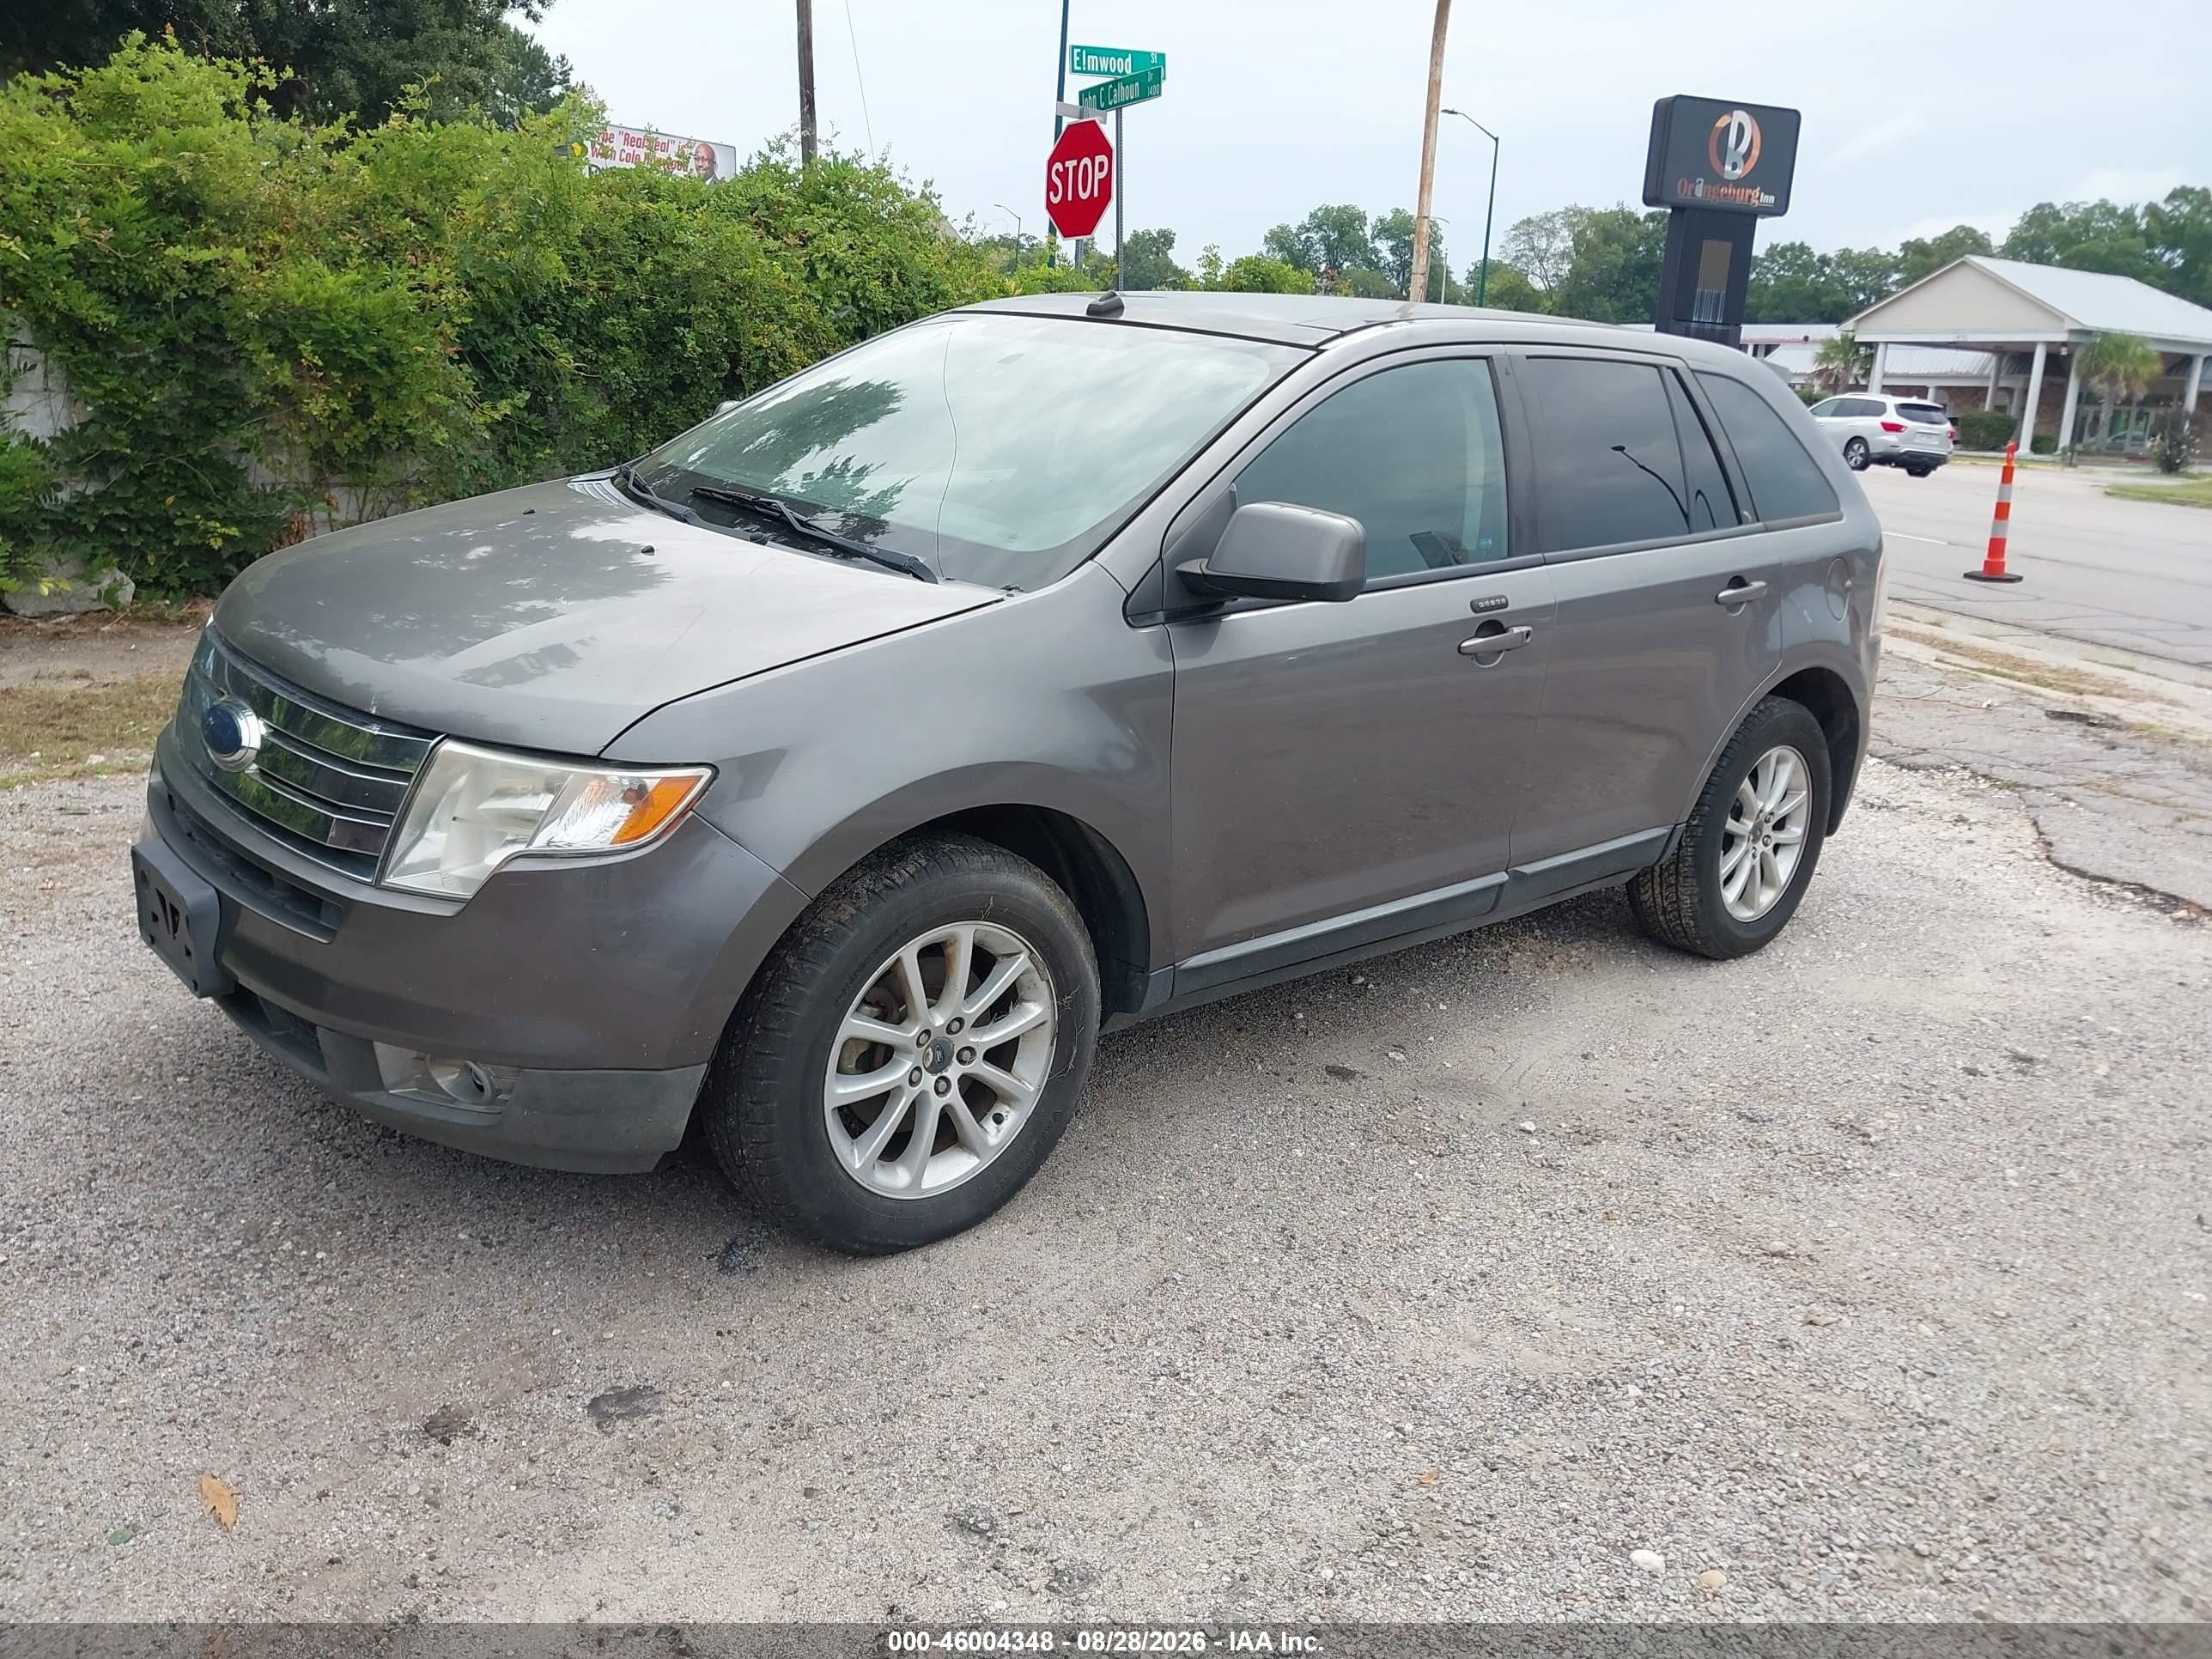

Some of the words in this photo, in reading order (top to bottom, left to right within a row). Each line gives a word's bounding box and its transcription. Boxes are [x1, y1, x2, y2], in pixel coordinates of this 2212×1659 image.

[1073, 48, 1132, 75] Elmwood
[1100, 87, 1104, 107] C
[1108, 82, 1139, 105] Calhoun
[1147, 71, 1153, 82] Dr
[647, 137, 676, 153] eal"
[1049, 154, 1109, 204] STOP
[1676, 177, 1760, 207] Orangeburg
[1759, 191, 1775, 204] Inn
